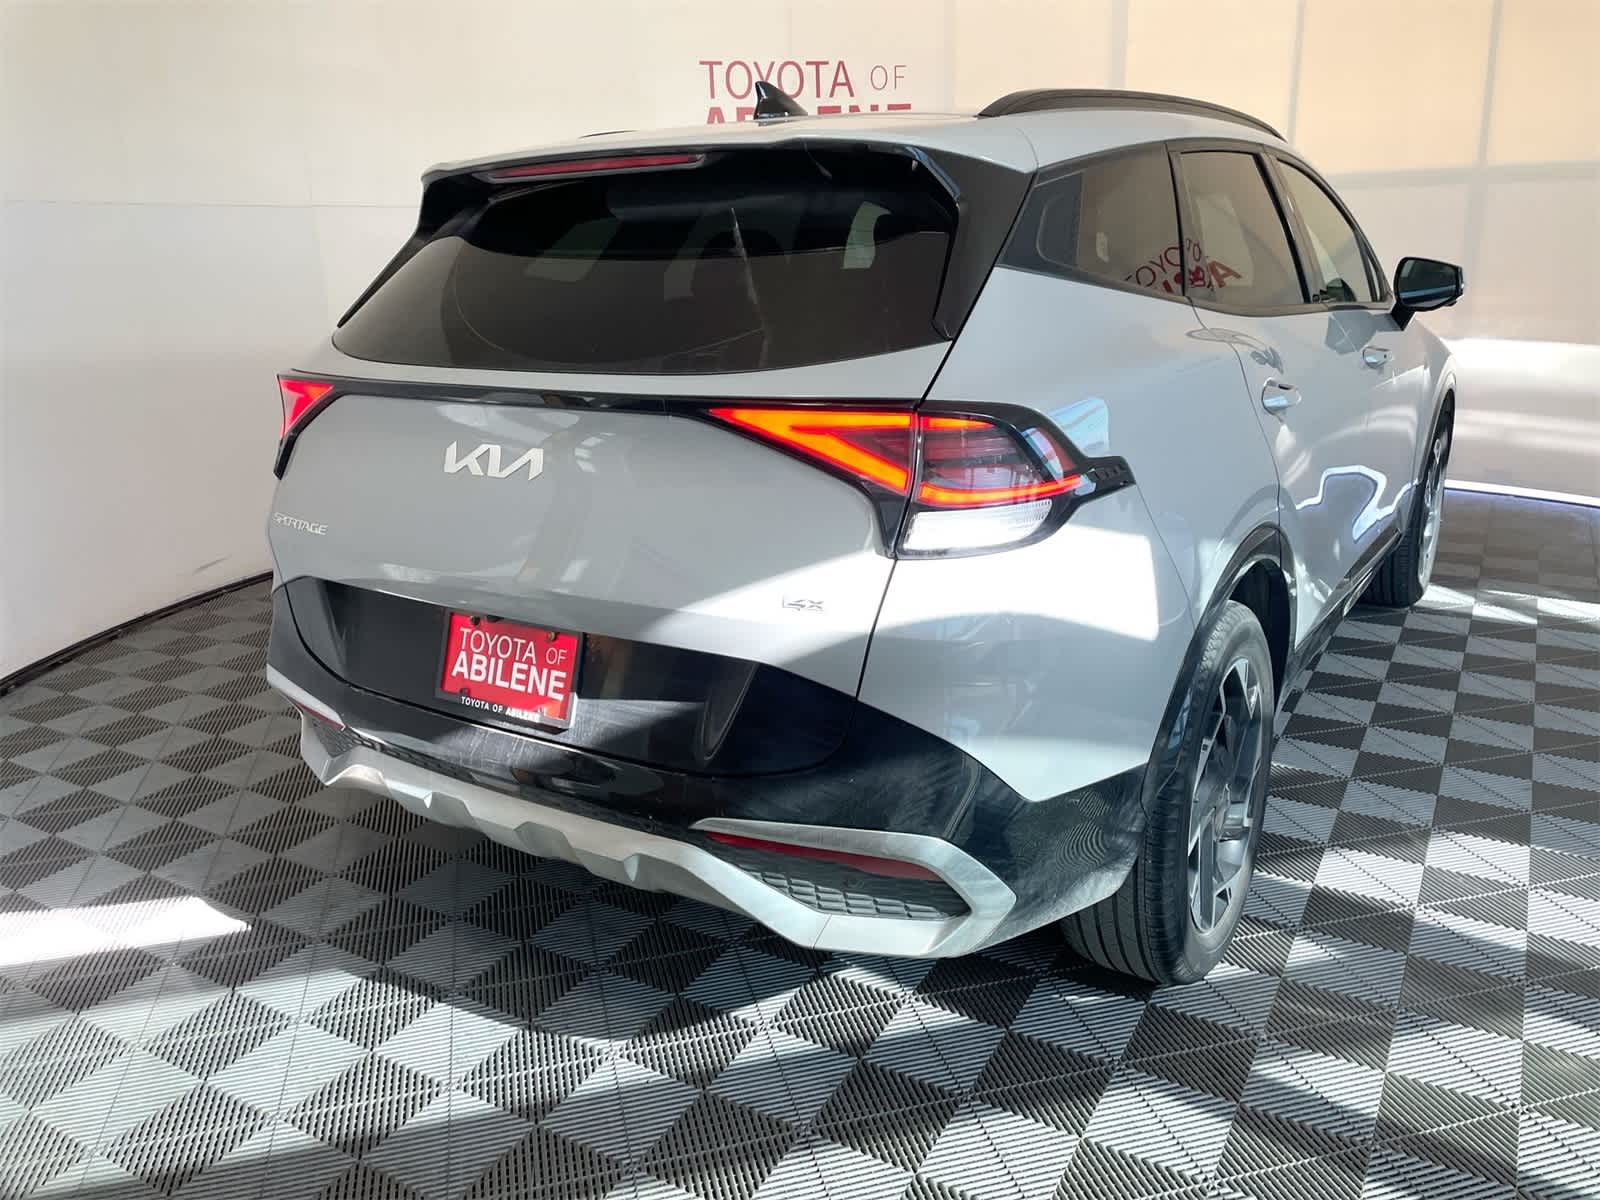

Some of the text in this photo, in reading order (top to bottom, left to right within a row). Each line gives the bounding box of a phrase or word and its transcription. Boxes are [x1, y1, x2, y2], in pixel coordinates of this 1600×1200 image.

[699, 60, 907, 99] TOYOTA OF
[444, 441, 544, 480] KIA
[459, 627, 567, 664] TOYOTA OF
[451, 651, 566, 701] ABILENE
[461, 696, 489, 710] TOYOTA
[492, 703, 503, 713] OF
